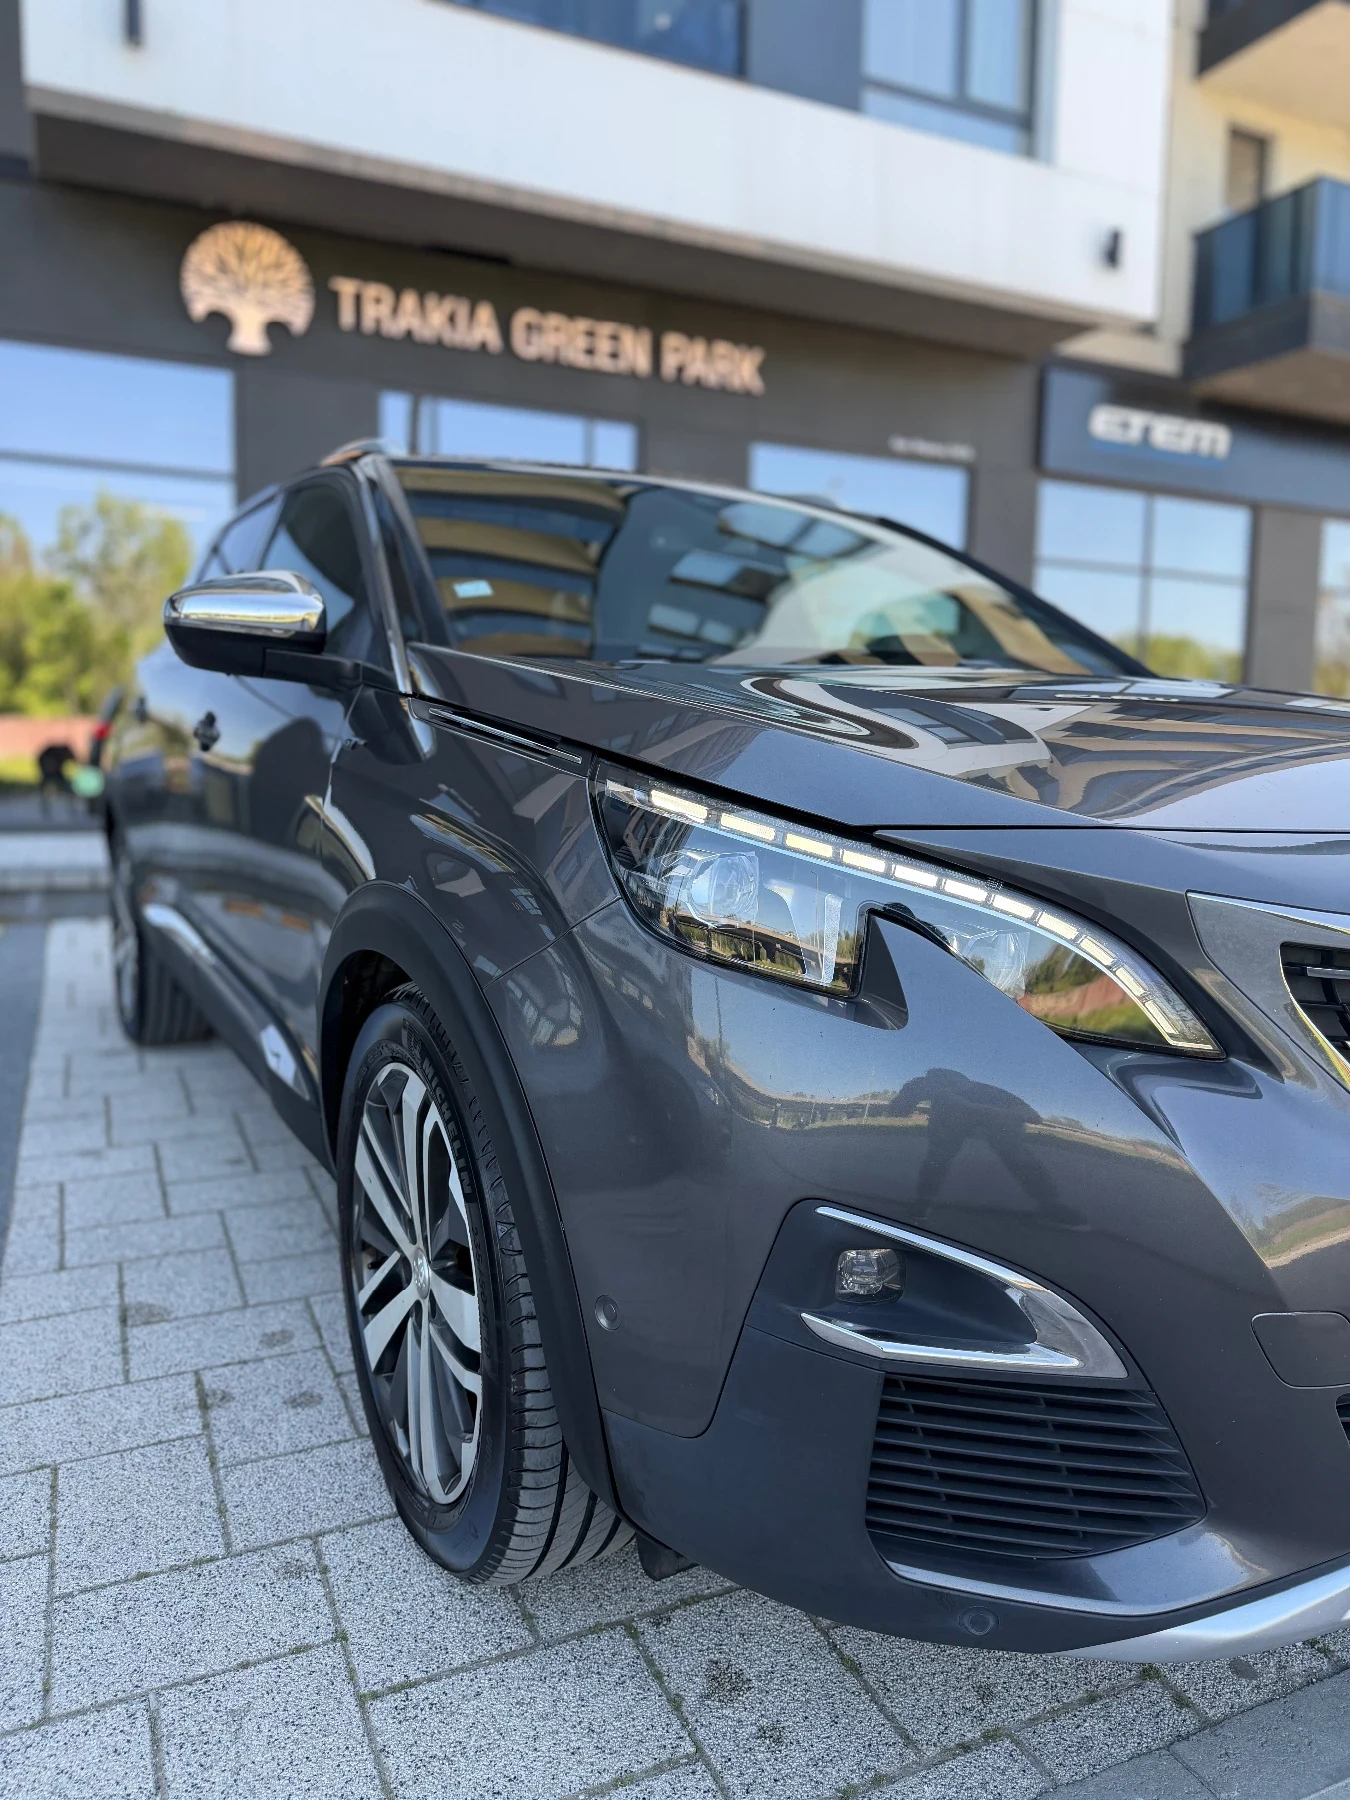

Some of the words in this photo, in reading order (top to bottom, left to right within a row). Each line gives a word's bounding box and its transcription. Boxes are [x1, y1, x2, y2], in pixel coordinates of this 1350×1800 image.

[329, 274, 503, 354] TRAKIA
[511, 306, 652, 378] GREEN
[660, 330, 767, 396] PARK
[423, 1058, 473, 1194] MICHELIN
